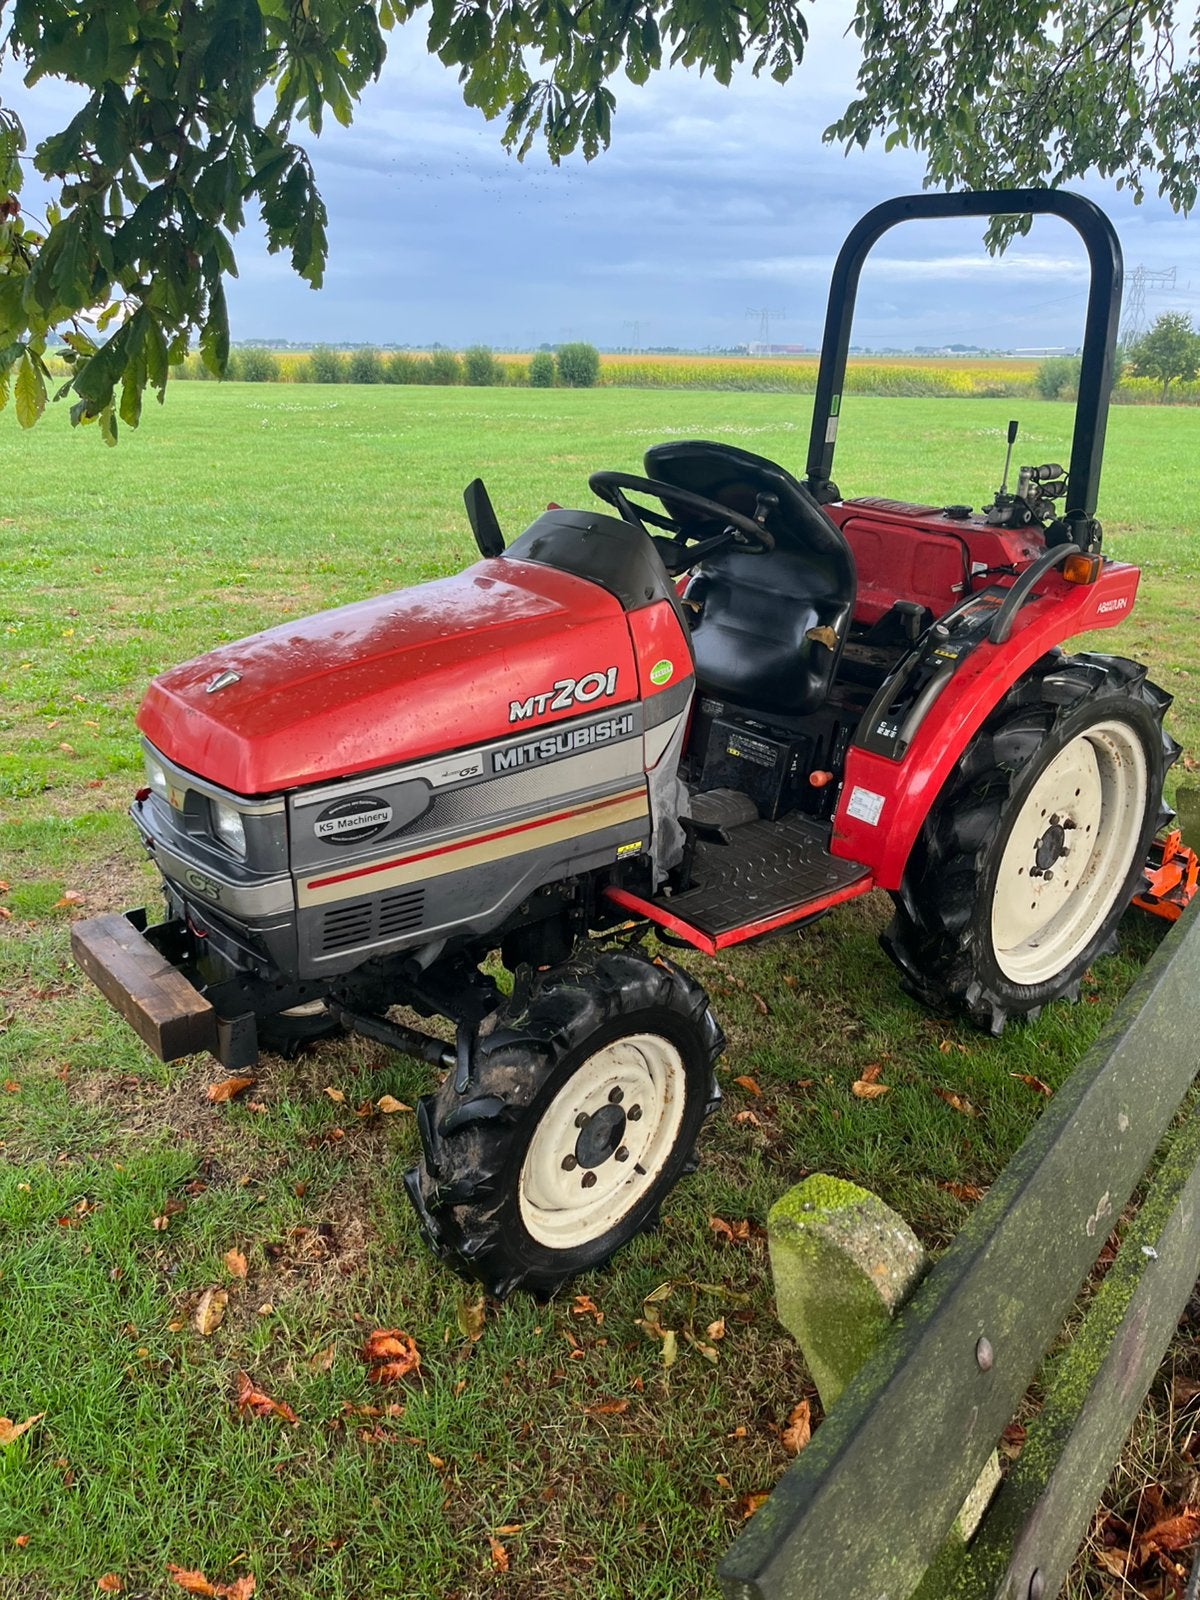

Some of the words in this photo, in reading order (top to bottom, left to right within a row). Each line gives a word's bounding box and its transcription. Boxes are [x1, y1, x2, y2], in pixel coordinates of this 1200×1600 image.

[509, 667, 618, 722] MT201
[493, 715, 634, 772] MITSUBISHI
[319, 822, 334, 833] KS
[338, 812, 388, 829] Machinery
[185, 869, 220, 900] GS
